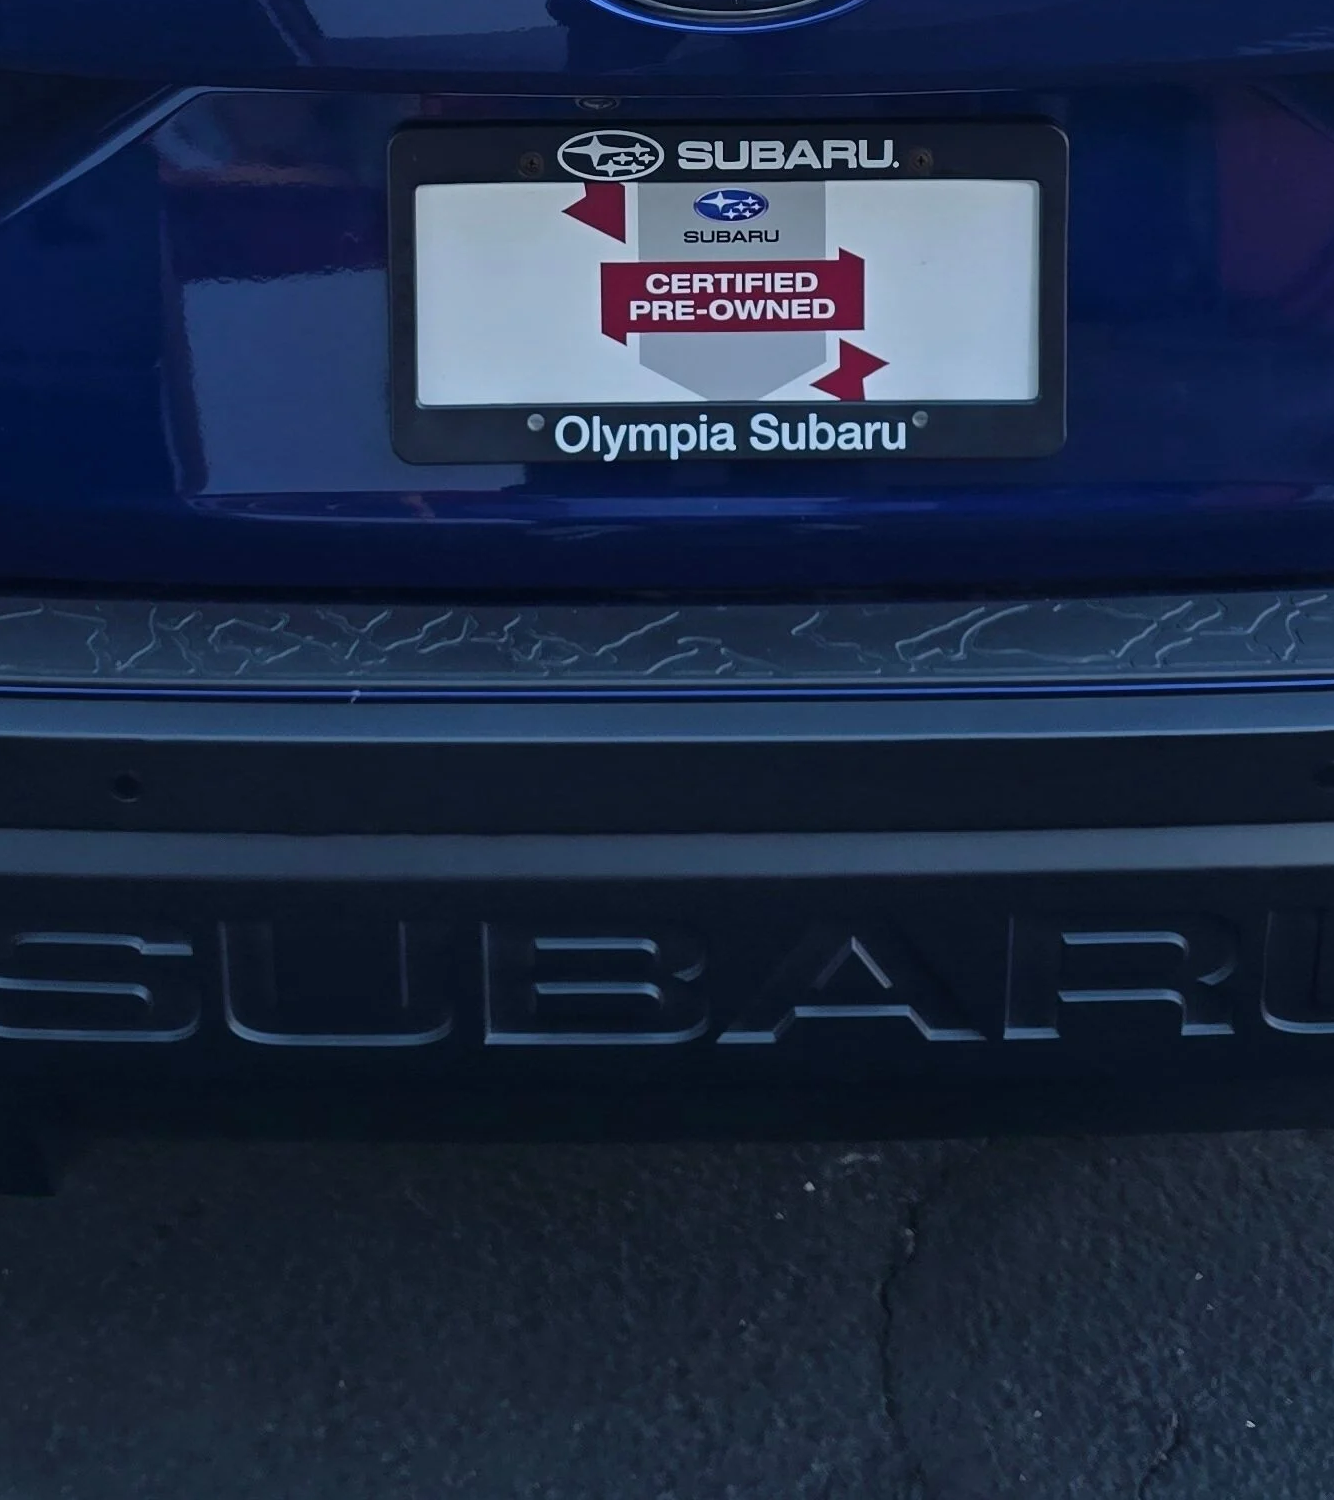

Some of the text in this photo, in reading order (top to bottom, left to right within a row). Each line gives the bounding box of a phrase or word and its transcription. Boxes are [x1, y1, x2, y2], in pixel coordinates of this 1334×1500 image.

[683, 230, 780, 244] SUBARU
[645, 272, 819, 296] CERTIFIED
[629, 299, 836, 322] PRE-OWNED
[554, 414, 907, 461] Olympia Subaru
